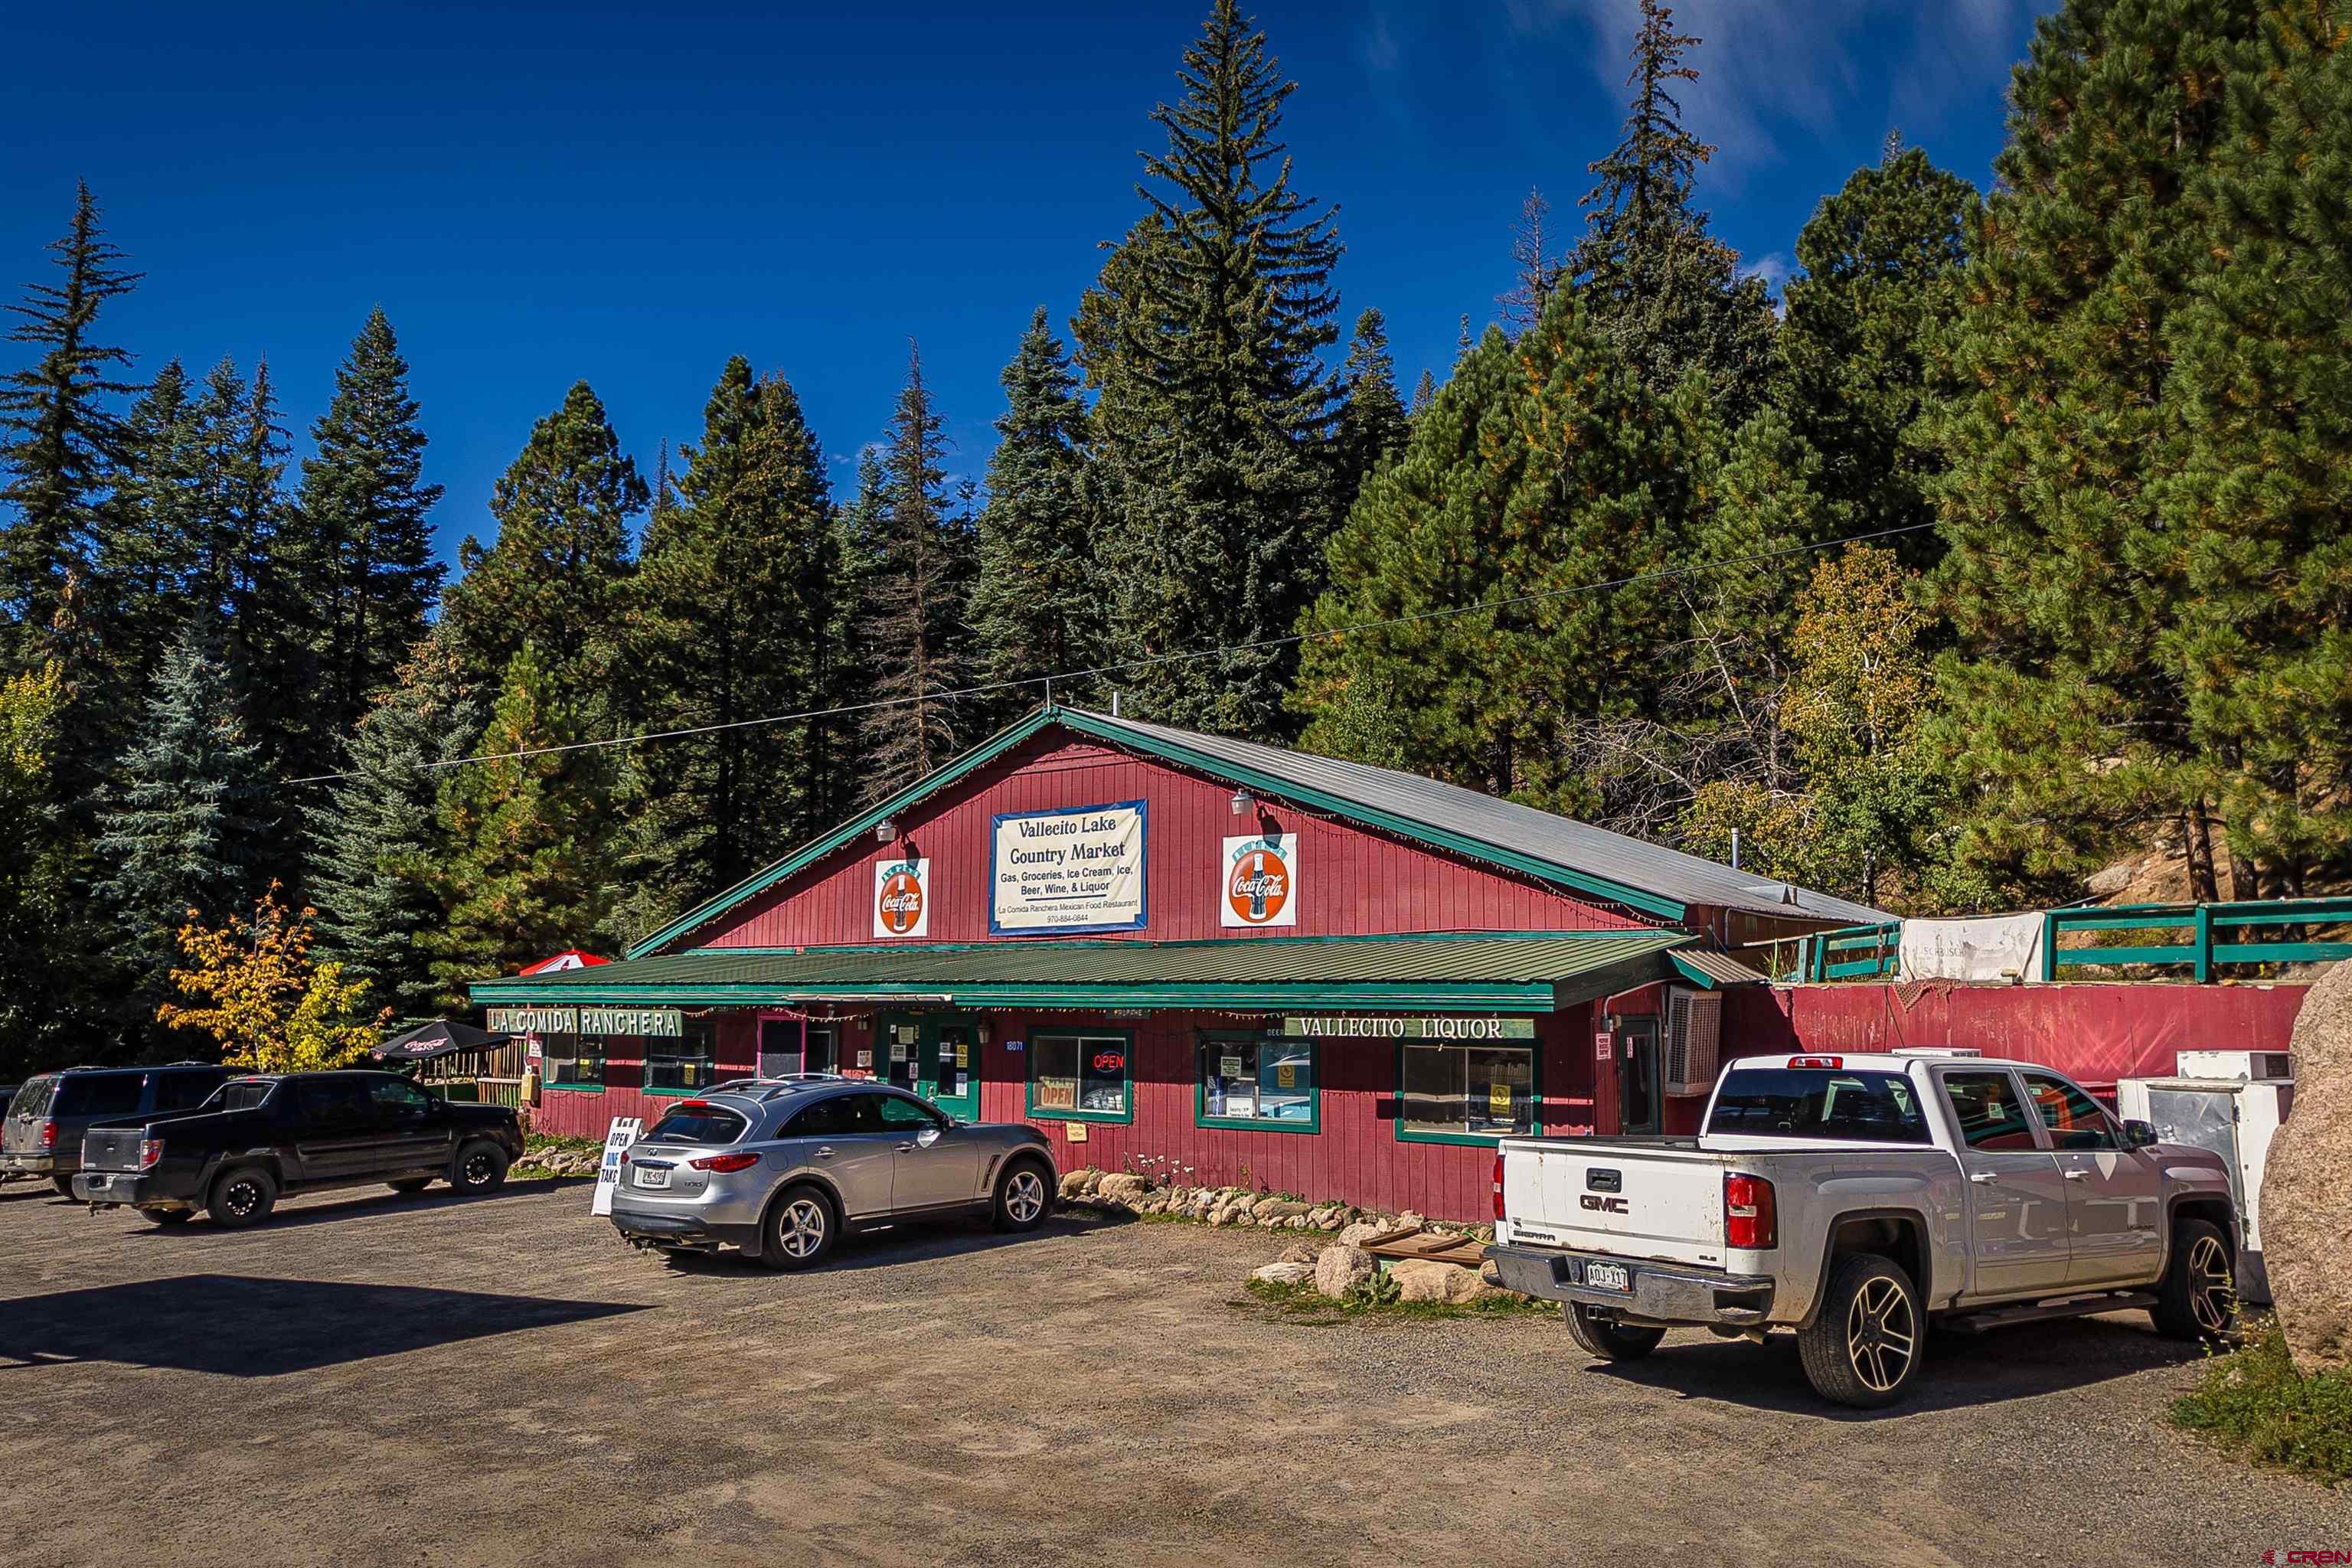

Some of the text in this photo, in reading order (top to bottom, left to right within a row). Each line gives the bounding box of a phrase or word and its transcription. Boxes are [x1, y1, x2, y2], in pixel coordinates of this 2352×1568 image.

[1019, 816, 1116, 838] Vallecito Lake
[1011, 841, 1125, 865] Country Market
[1000, 865, 1133, 883] Gas, Groceries, Ice Cream, Ice,
[1021, 881, 1110, 896] Beer, Wine, & Liquor
[1103, 900, 1138, 908] Restaurant
[491, 1011, 677, 1035] LA COMIDA RANCHERA
[1300, 1018, 1504, 1040] VALLECITO LIQUOR
[1093, 1054, 1124, 1068] OPEN
[1044, 1087, 1073, 1105] OPEN
[610, 1133, 629, 1147] OPEN
[601, 1169, 618, 1183] TAKE
[1580, 1194, 1628, 1214] GMC
[1513, 1230, 1556, 1242] SIERRA
